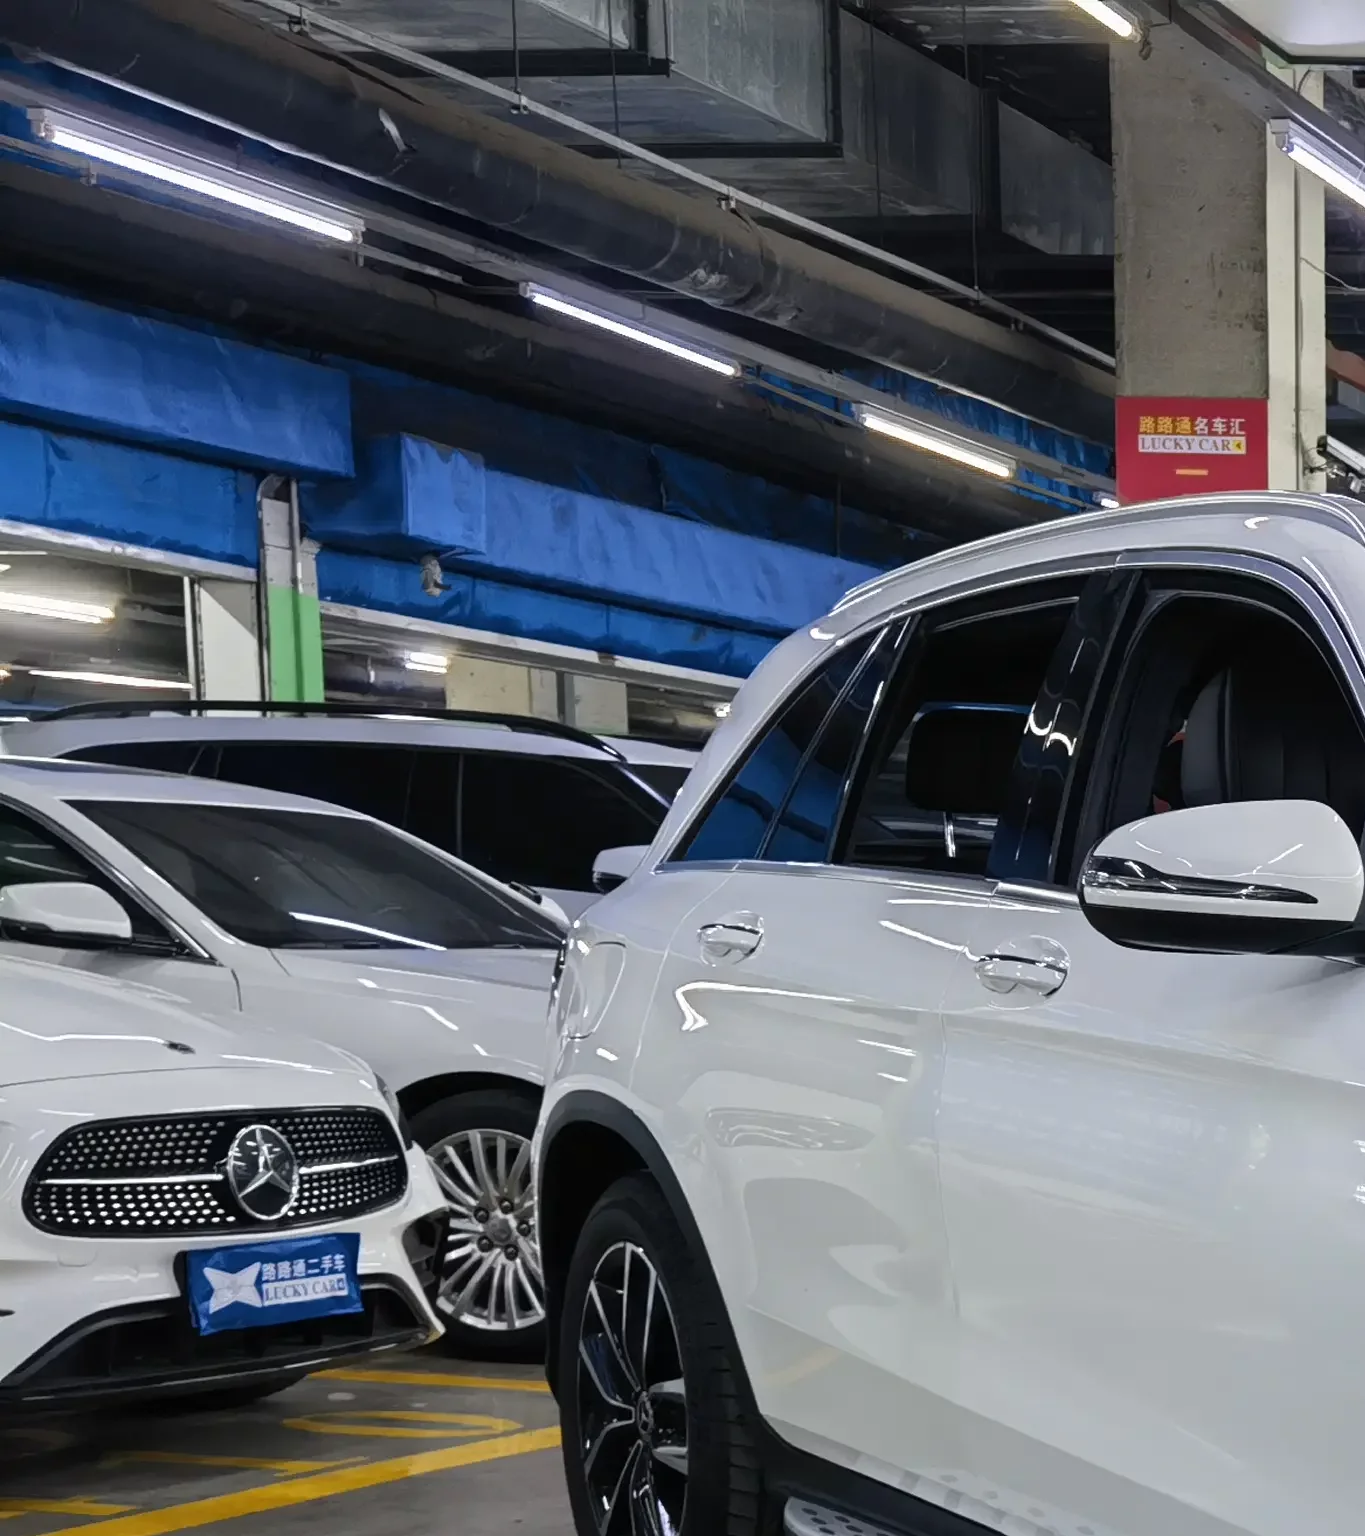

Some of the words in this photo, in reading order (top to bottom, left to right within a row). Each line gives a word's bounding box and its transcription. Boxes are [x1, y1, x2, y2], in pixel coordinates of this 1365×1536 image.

[1139, 416, 1246, 435] 路路通名车汇
[1140, 437, 1194, 451] LUCKY
[1199, 438, 1232, 452] CAR
[262, 1253, 346, 1281] 路路通二手车
[264, 1284, 310, 1301] LUCKY
[312, 1279, 338, 1295] CAR
